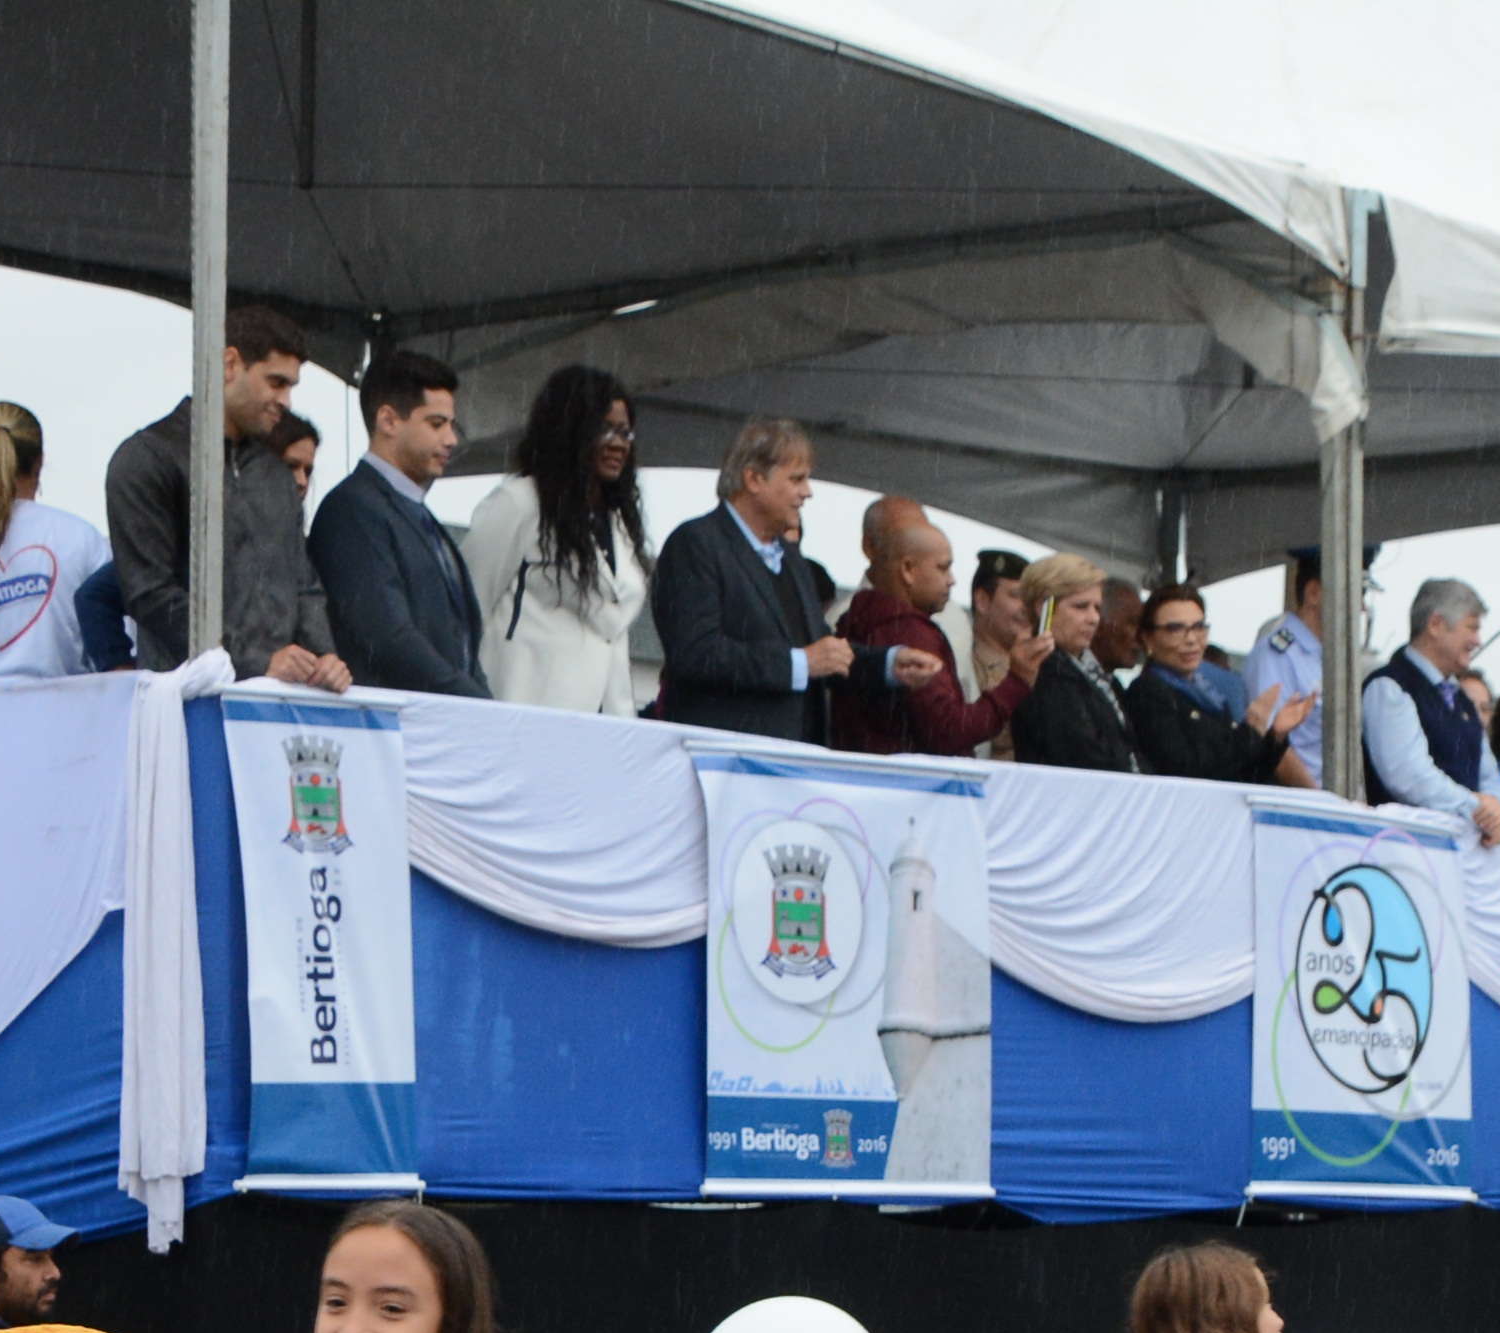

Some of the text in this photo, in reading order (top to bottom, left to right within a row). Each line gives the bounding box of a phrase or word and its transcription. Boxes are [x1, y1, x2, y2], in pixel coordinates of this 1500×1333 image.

[305, 866, 342, 1065] Bertioga
[1305, 952, 1356, 976] anos
[1312, 1026, 1414, 1054] emancipação
[708, 1126, 887, 1160] 1991 Bertioga 2016
[1260, 1137, 1460, 1168] 1991 2016
